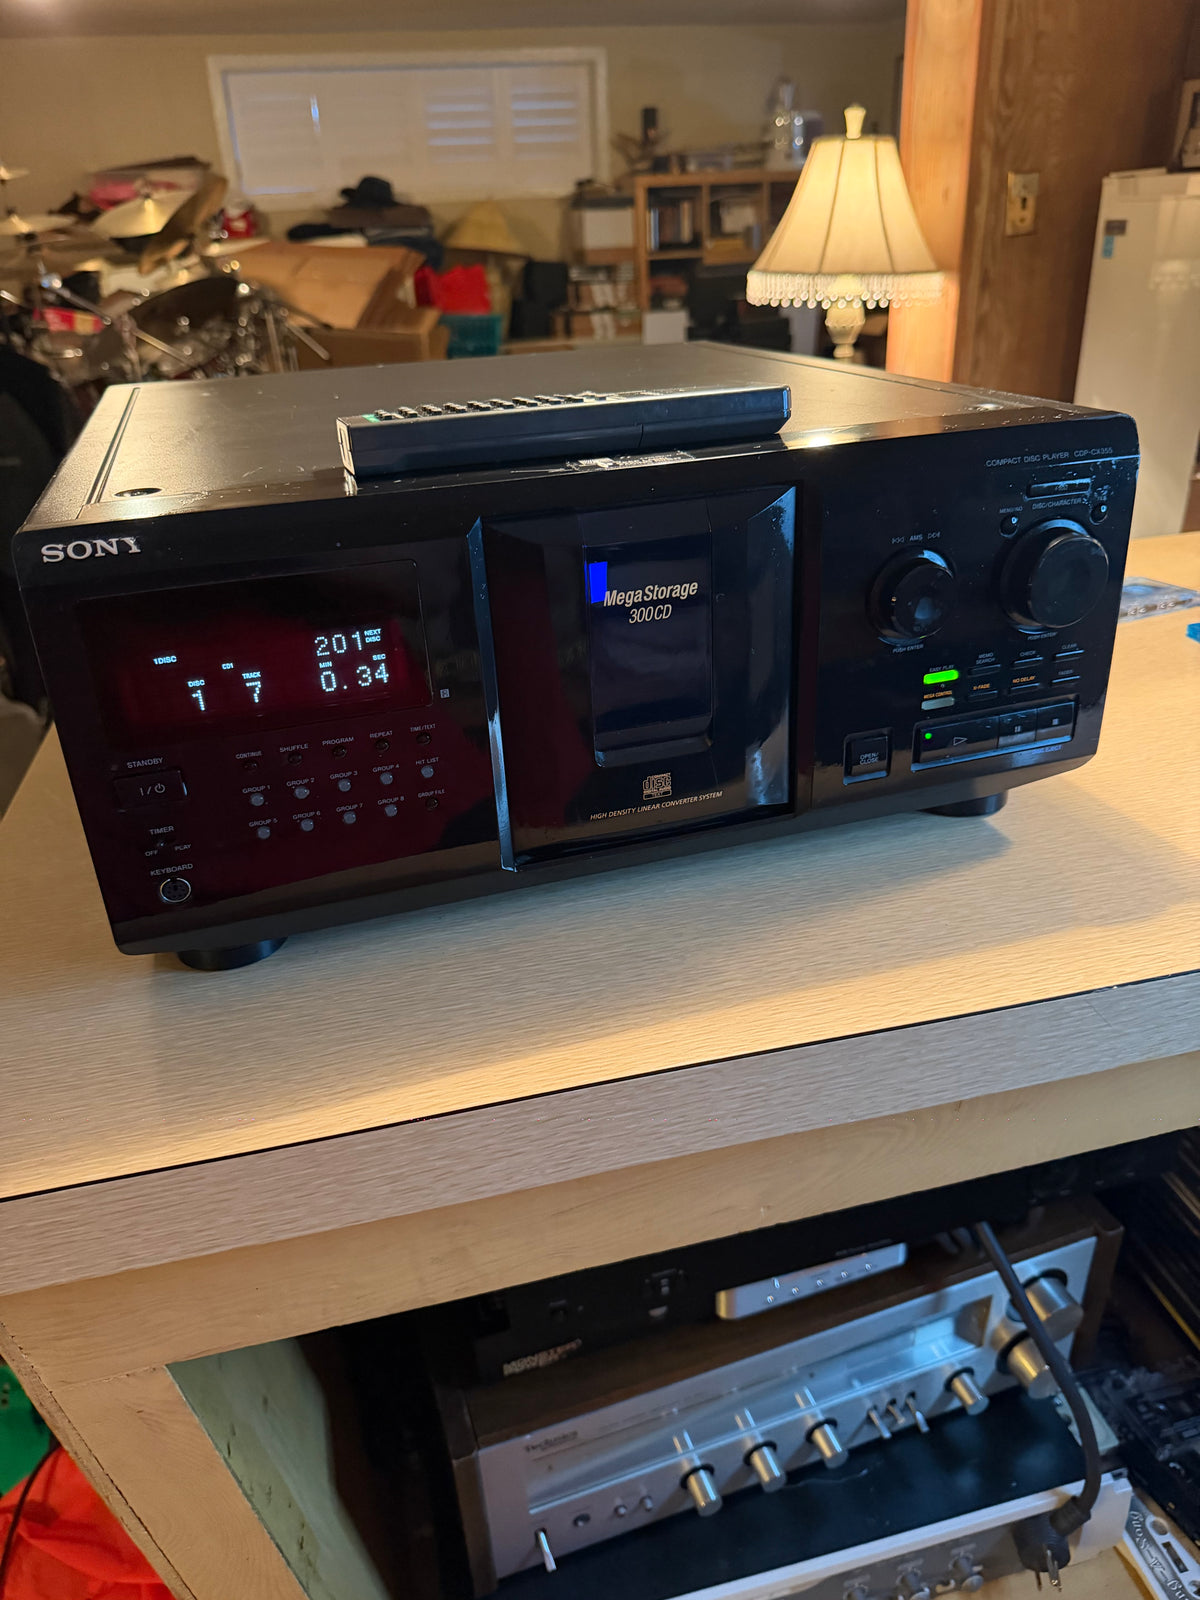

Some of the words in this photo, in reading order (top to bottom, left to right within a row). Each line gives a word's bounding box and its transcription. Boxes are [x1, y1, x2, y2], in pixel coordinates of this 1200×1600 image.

[985, 456, 1021, 467] COMPACT
[1023, 454, 1041, 463] DISC
[1042, 451, 1070, 460] PLAYER
[41, 536, 141, 563] SONY
[364, 628, 382, 636] NEXT
[315, 631, 362, 656] 201
[365, 635, 381, 643] DISC
[319, 661, 333, 669] MIN
[242, 671, 261, 679] TRACK
[187, 679, 205, 688] DISC
[245, 681, 261, 703] 7
[192, 690, 205, 711] 1
[369, 730, 393, 739] REPEAT
[322, 736, 354, 746] PROGRAM
[279, 743, 309, 753] SHUFFLE
[127, 757, 163, 769] STANDBY
[372, 764, 395, 773] GROUP
[329, 771, 352, 780] GROUP
[286, 778, 309, 787] GROUP
[242, 785, 266, 794] GROUP
[377, 797, 399, 805] GROUP
[589, 812, 607, 820] HIGH
[608, 807, 636, 818] DENSITY
[637, 803, 660, 812] LINEAR
[661, 796, 698, 808] CONVERTER
[698, 791, 723, 801] SYSTEM
[336, 804, 358, 812] GROUP
[292, 811, 315, 820] GROUP
[248, 819, 272, 828] GROUP
[149, 825, 174, 835] TIMER
[174, 843, 191, 851] PLAY
[145, 849, 158, 857] OFF
[150, 863, 193, 876] KEYBOARD
